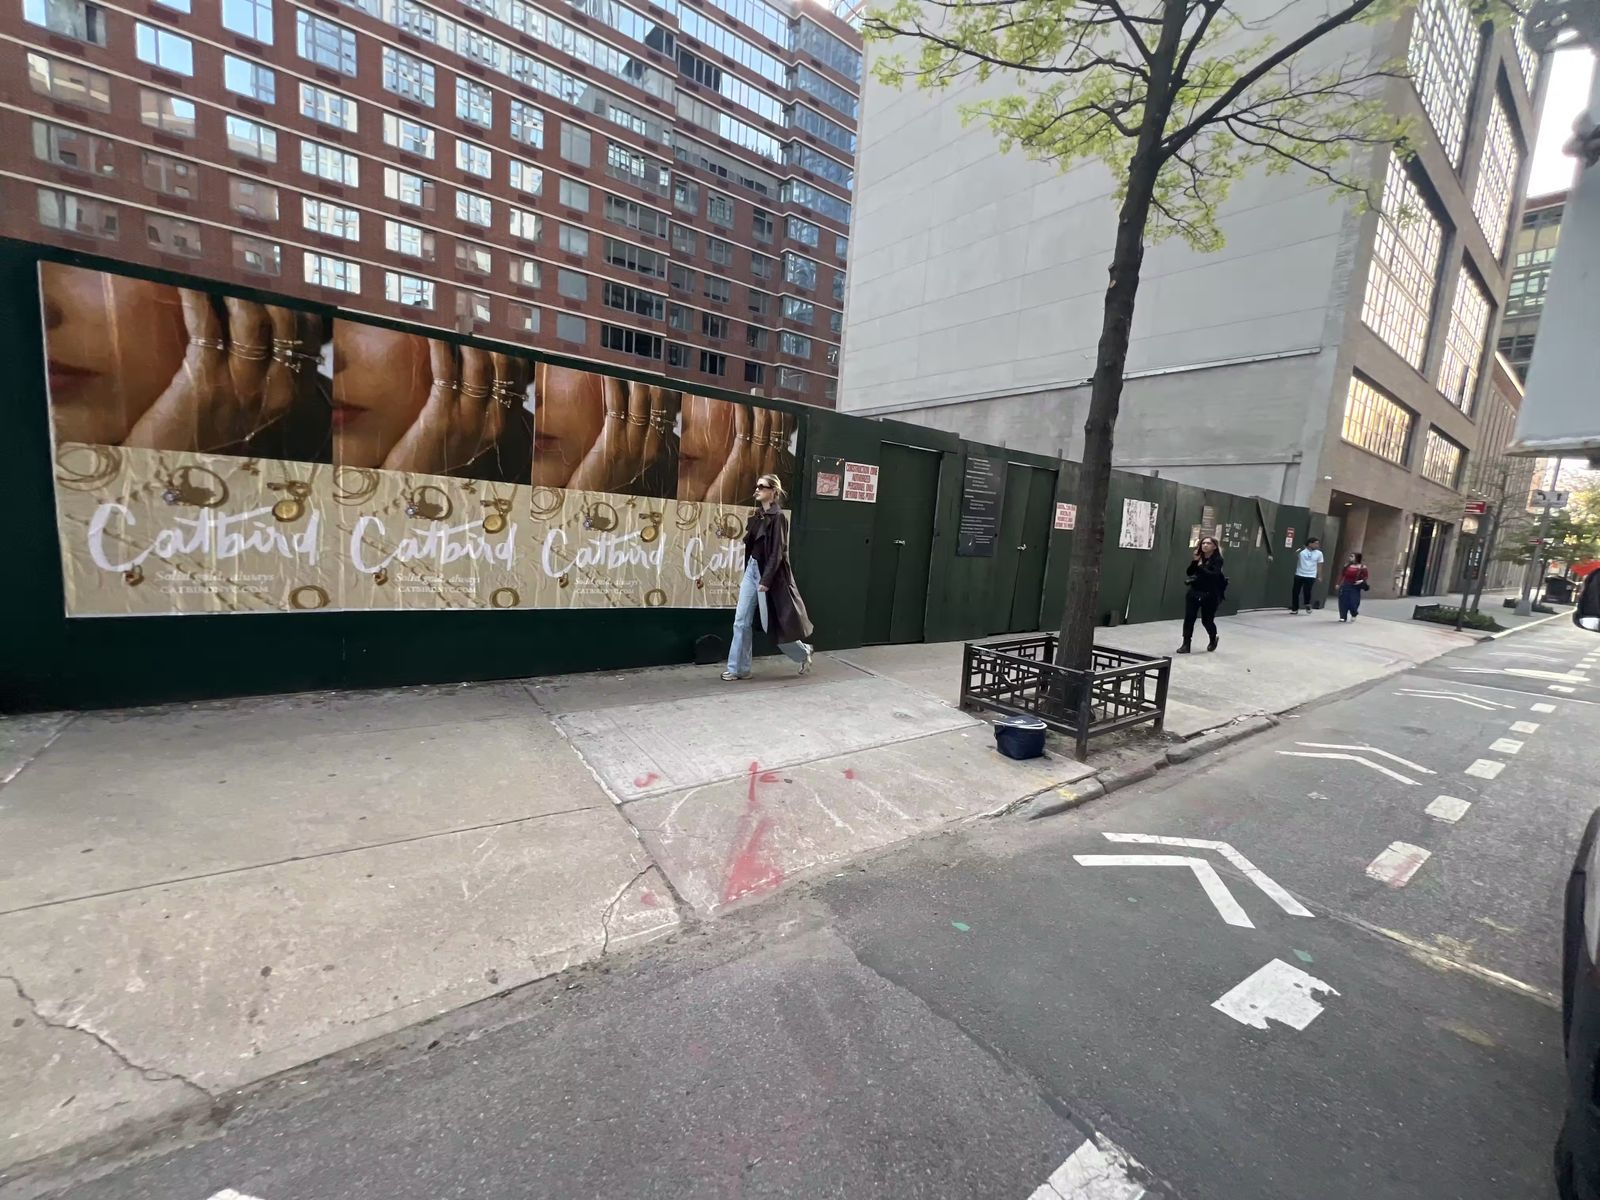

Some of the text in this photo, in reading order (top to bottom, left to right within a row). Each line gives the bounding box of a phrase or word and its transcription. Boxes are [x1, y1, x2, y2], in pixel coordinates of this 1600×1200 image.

[88, 503, 320, 572] Catbird
[350, 516, 518, 574] Catbird
[541, 528, 667, 578] Catbird
[683, 537, 746, 580] Catb
